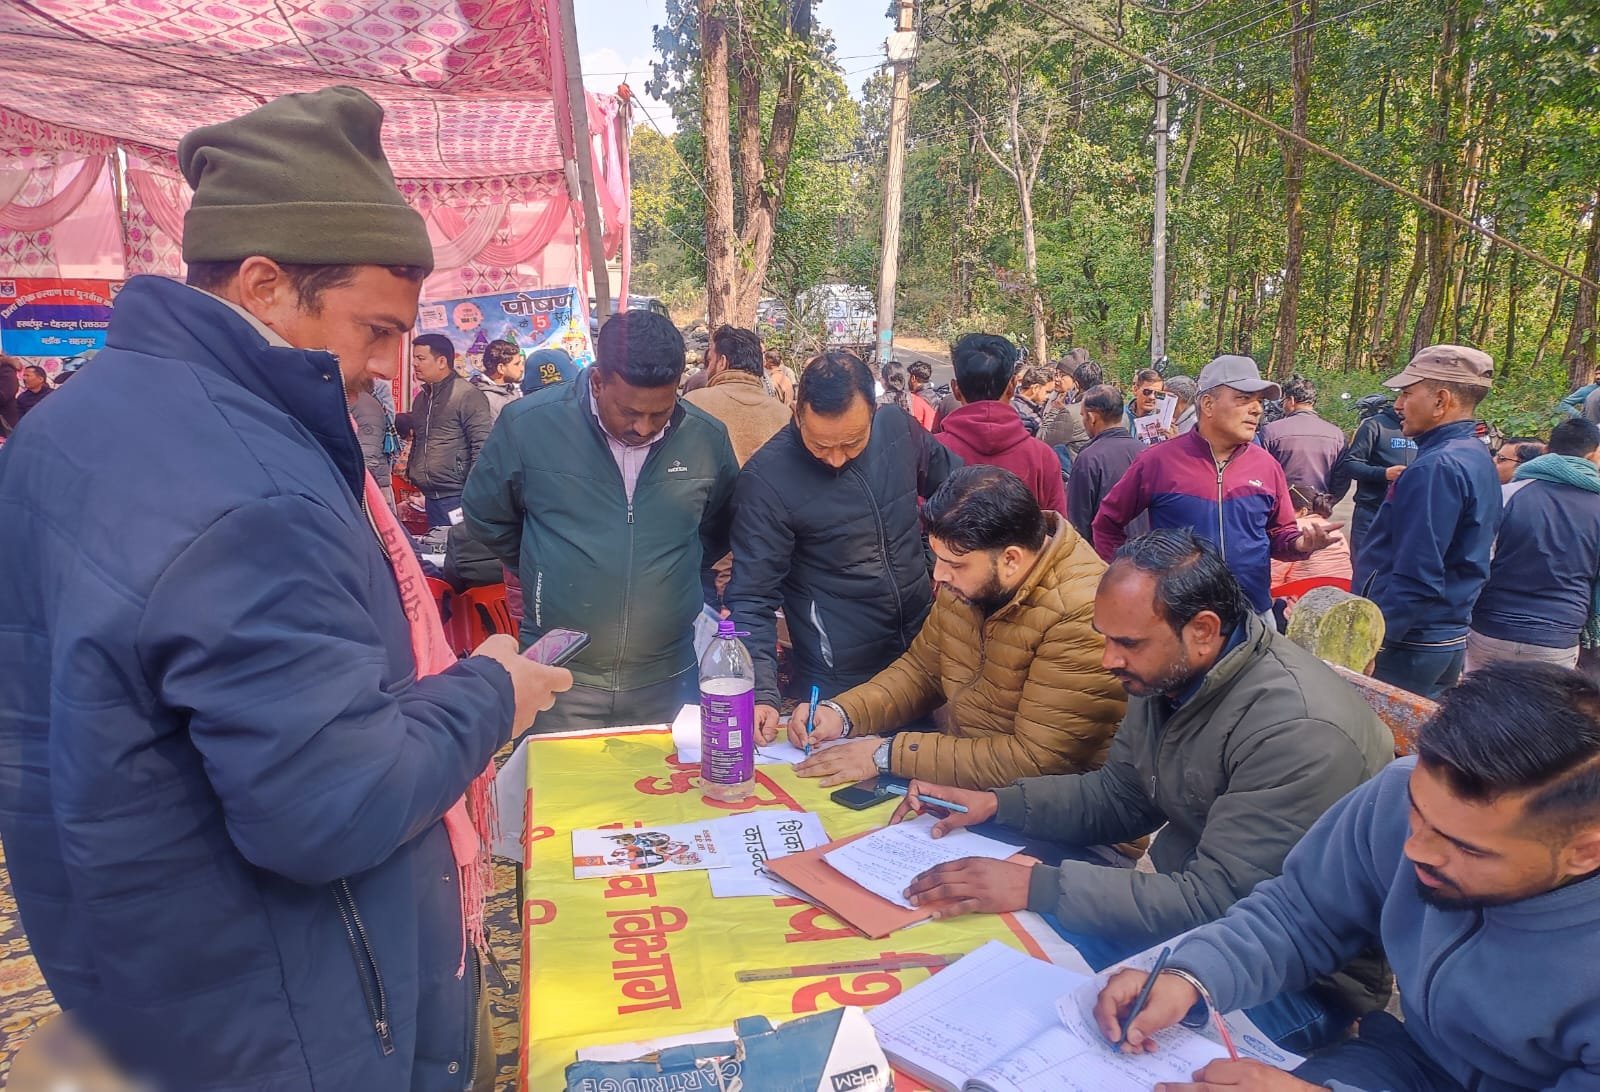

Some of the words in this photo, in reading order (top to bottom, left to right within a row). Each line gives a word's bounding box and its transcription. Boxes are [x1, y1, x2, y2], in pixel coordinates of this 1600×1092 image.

[501, 292, 574, 317] पोषण
[535, 314, 547, 328] 5
[776, 819, 806, 854] शिका
[606, 905, 689, 1016] विभाग
